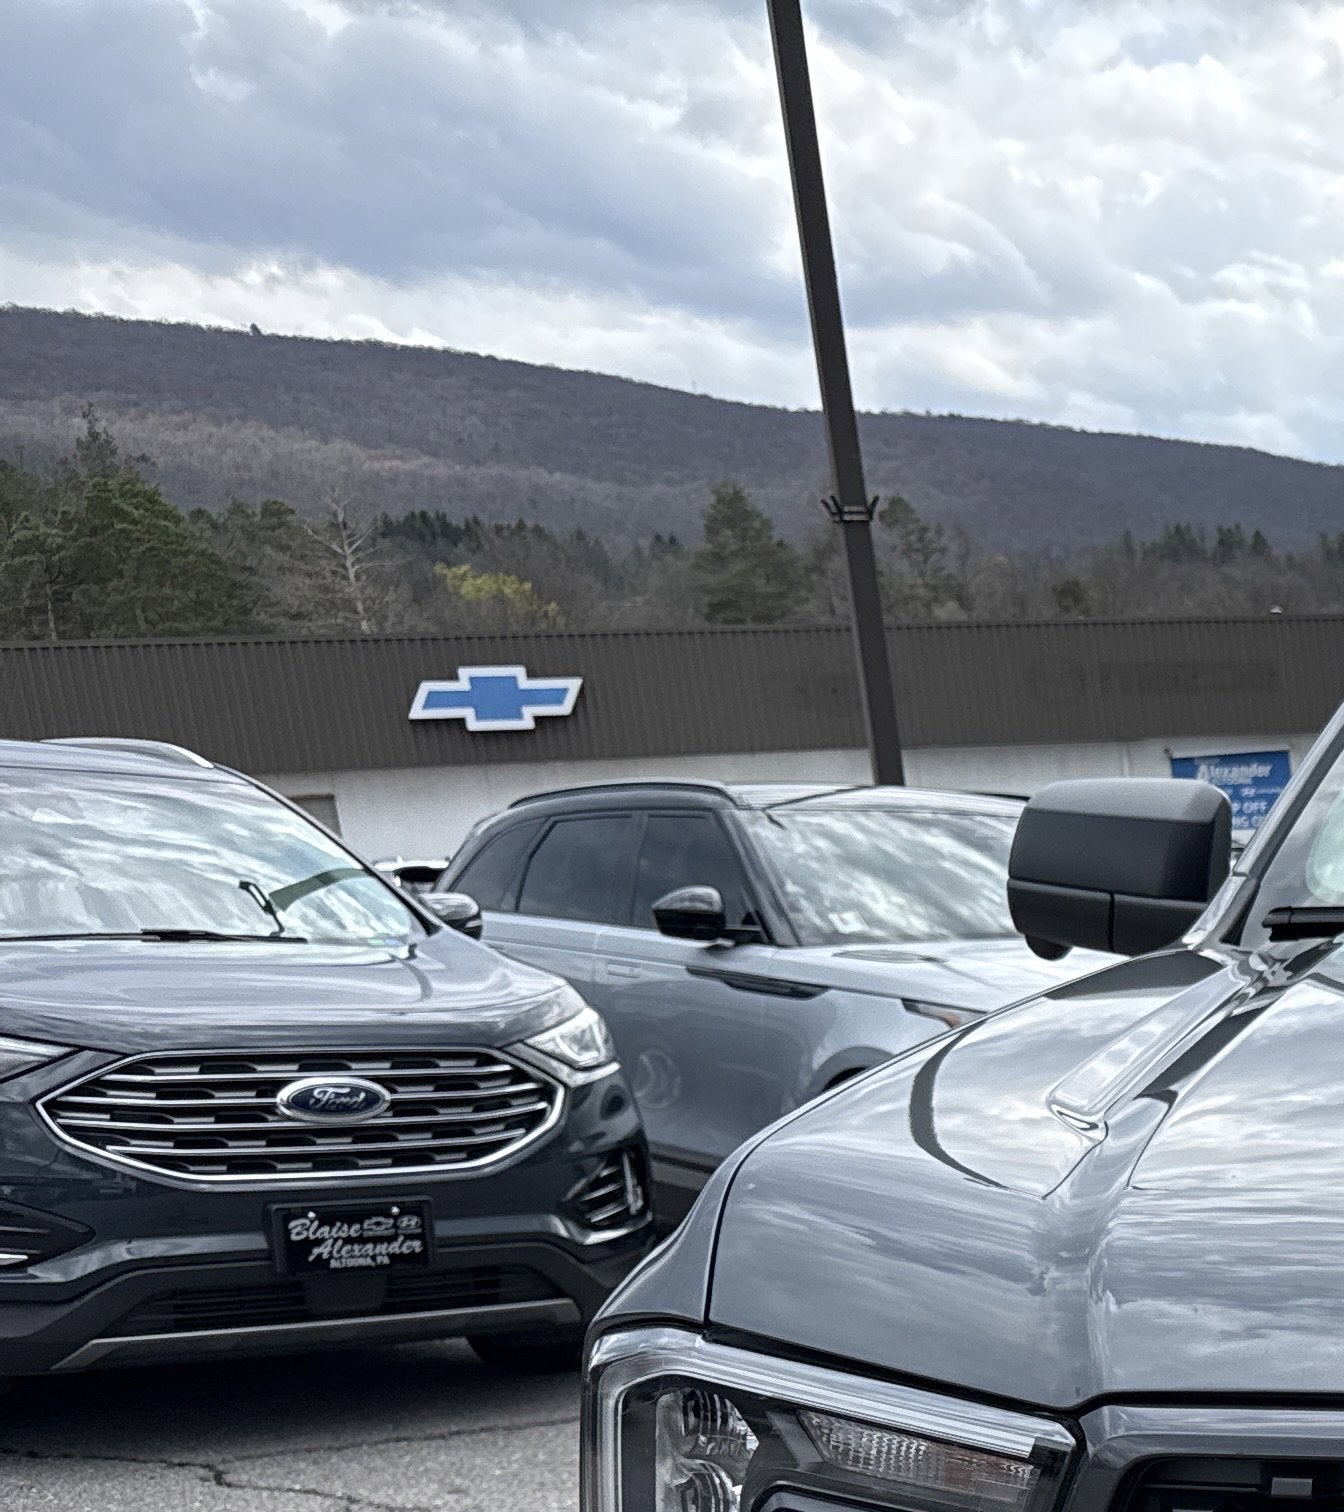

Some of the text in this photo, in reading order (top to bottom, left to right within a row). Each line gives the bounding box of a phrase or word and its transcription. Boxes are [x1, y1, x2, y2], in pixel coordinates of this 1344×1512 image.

[309, 1086, 366, 1110] Ford
[288, 1217, 362, 1241] Blaise
[308, 1235, 424, 1262] Alexander
